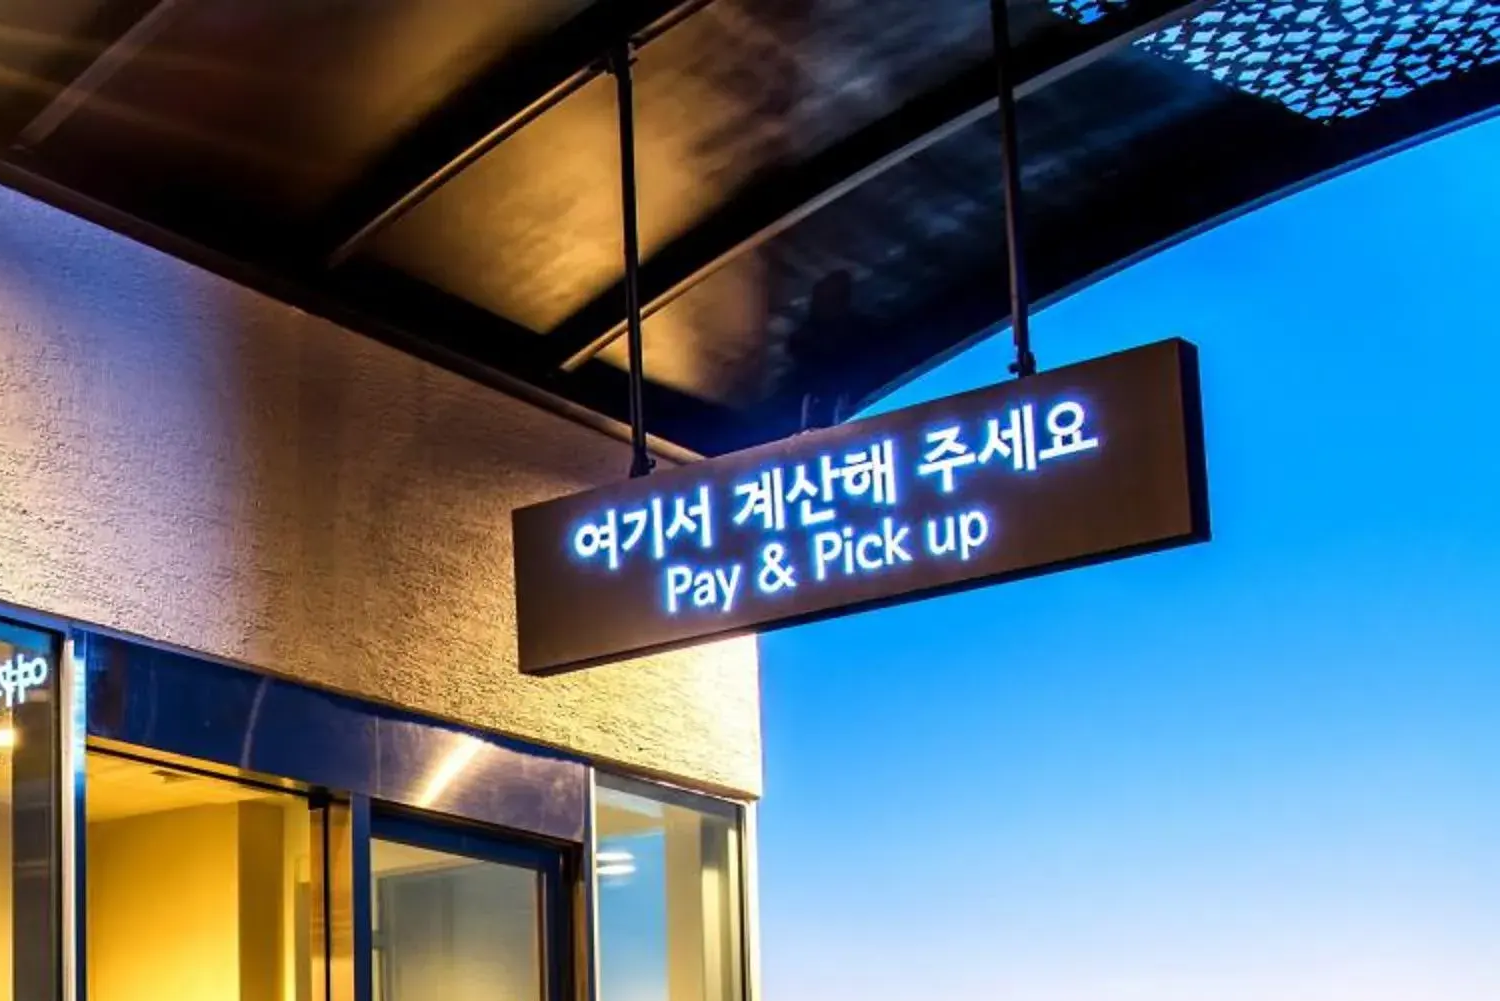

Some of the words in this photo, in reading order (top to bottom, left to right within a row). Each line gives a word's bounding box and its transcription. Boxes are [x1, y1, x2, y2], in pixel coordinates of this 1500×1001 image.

[573, 487, 712, 568] 여기서
[733, 439, 898, 531] 계산해
[918, 400, 1100, 492] 주세요
[666, 564, 741, 613] Pay
[758, 543, 796, 594] &
[814, 518, 912, 581] Pick
[927, 508, 990, 560] up
